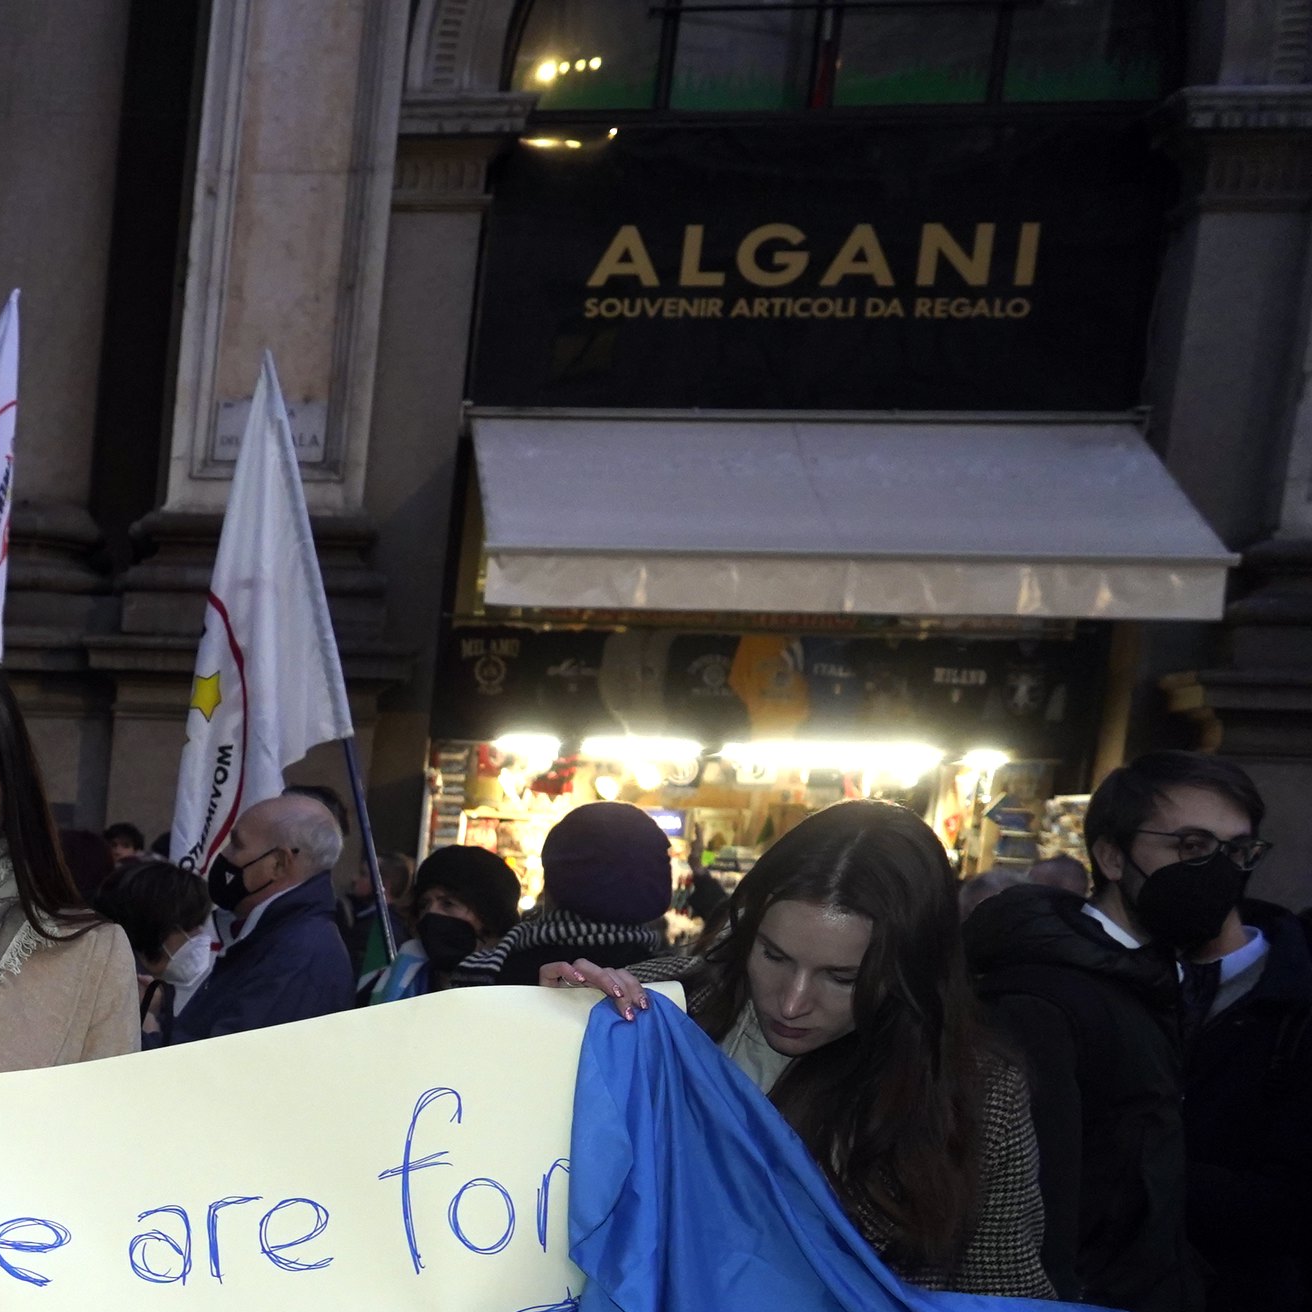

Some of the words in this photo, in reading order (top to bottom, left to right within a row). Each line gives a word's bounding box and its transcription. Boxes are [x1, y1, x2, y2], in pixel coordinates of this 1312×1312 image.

[586, 222, 1042, 287] ALGANI
[584, 298, 723, 319] SOUVENIR
[731, 298, 857, 319] ARTICOLI
[864, 298, 905, 319] DA
[914, 298, 1032, 319] REGALO
[128, 1195, 334, 1285] are
[378, 1087, 571, 1275] for
